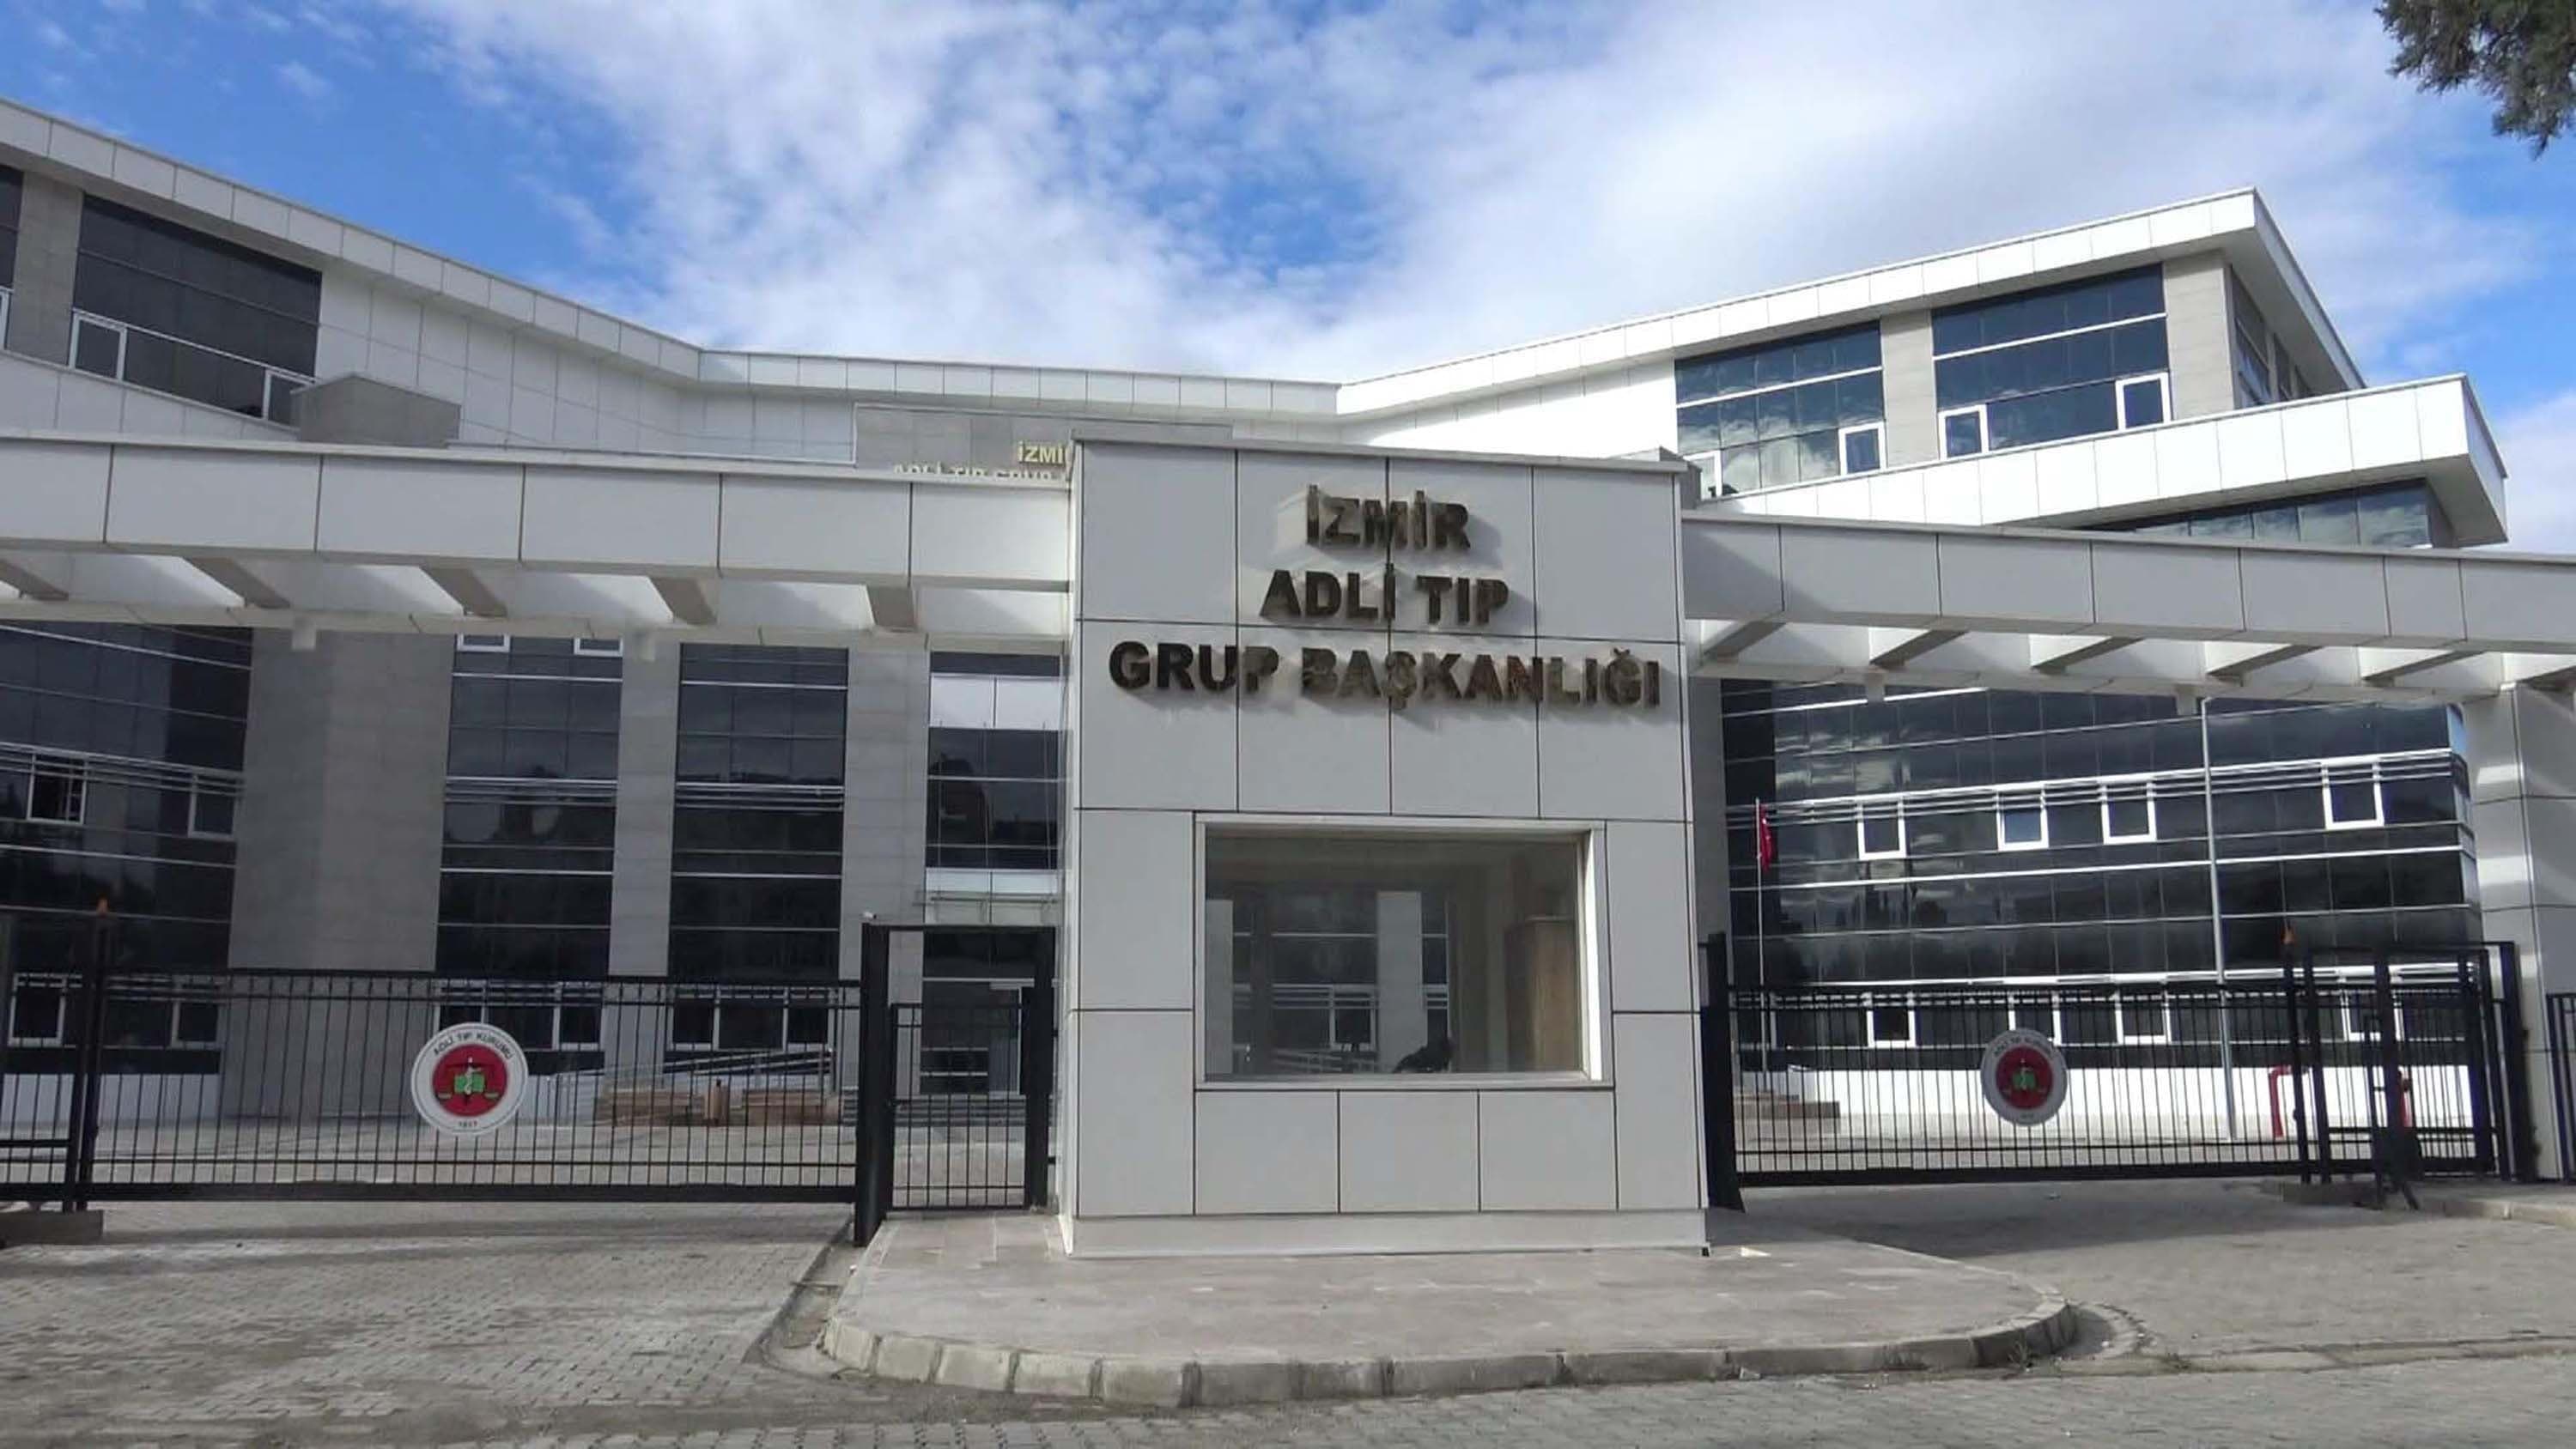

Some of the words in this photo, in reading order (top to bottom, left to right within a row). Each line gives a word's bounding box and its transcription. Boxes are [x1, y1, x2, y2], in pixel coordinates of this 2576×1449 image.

[1017, 440, 1070, 464] İZMİ
[1307, 484, 1471, 549] İZMİR
[1260, 563, 1396, 621] ADLİ
[1416, 574, 1509, 625] TIP
[1109, 641, 1279, 693] GRUP
[1301, 647, 1661, 710] BAŞKANLIĞI
